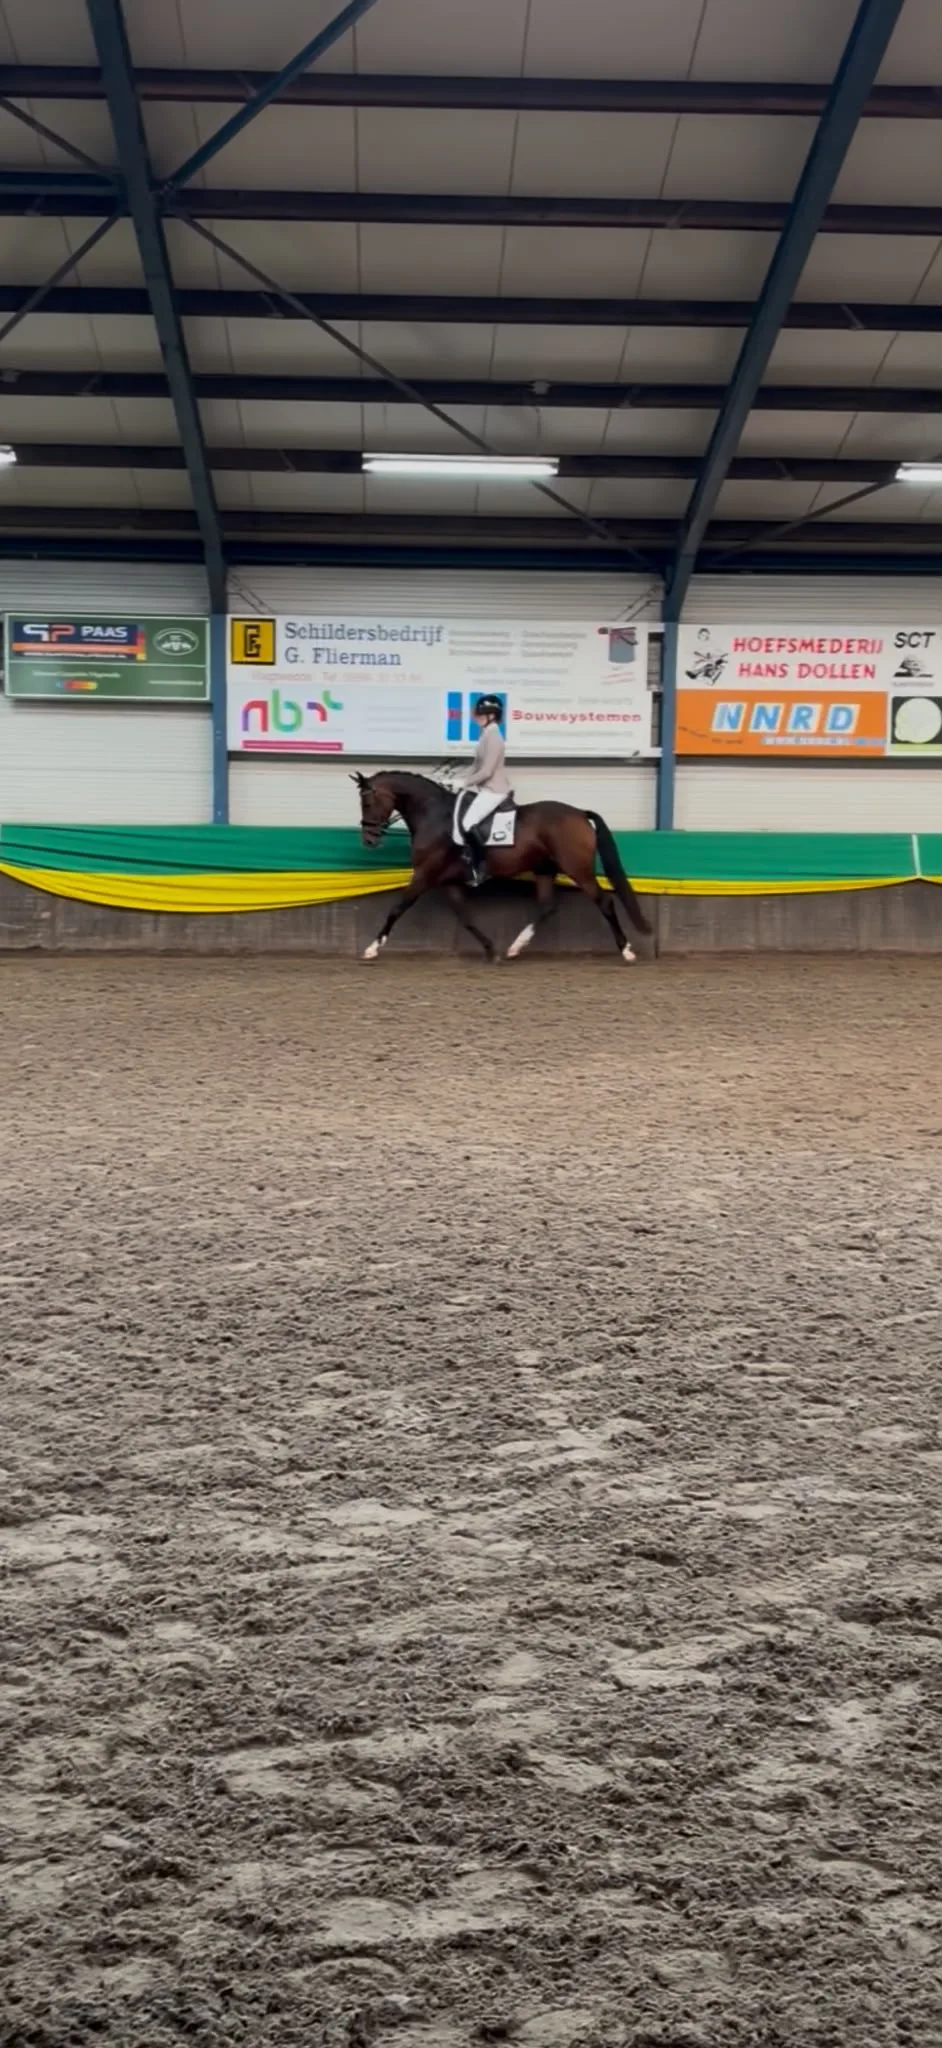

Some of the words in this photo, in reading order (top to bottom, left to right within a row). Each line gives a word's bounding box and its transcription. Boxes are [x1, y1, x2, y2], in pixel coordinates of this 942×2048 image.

[80, 626, 128, 638] PAAS
[284, 621, 444, 647] Schildersbedrijf
[894, 632, 935, 648] SCT
[732, 637, 883, 654] HOEFSMEDERIJ
[284, 647, 304, 664] G.
[311, 647, 402, 666] Flierman
[738, 663, 789, 678] HANS
[796, 663, 876, 679] DOLLEN
[512, 709, 642, 723] Bouwsystemen
[711, 702, 861, 734] NNRD
